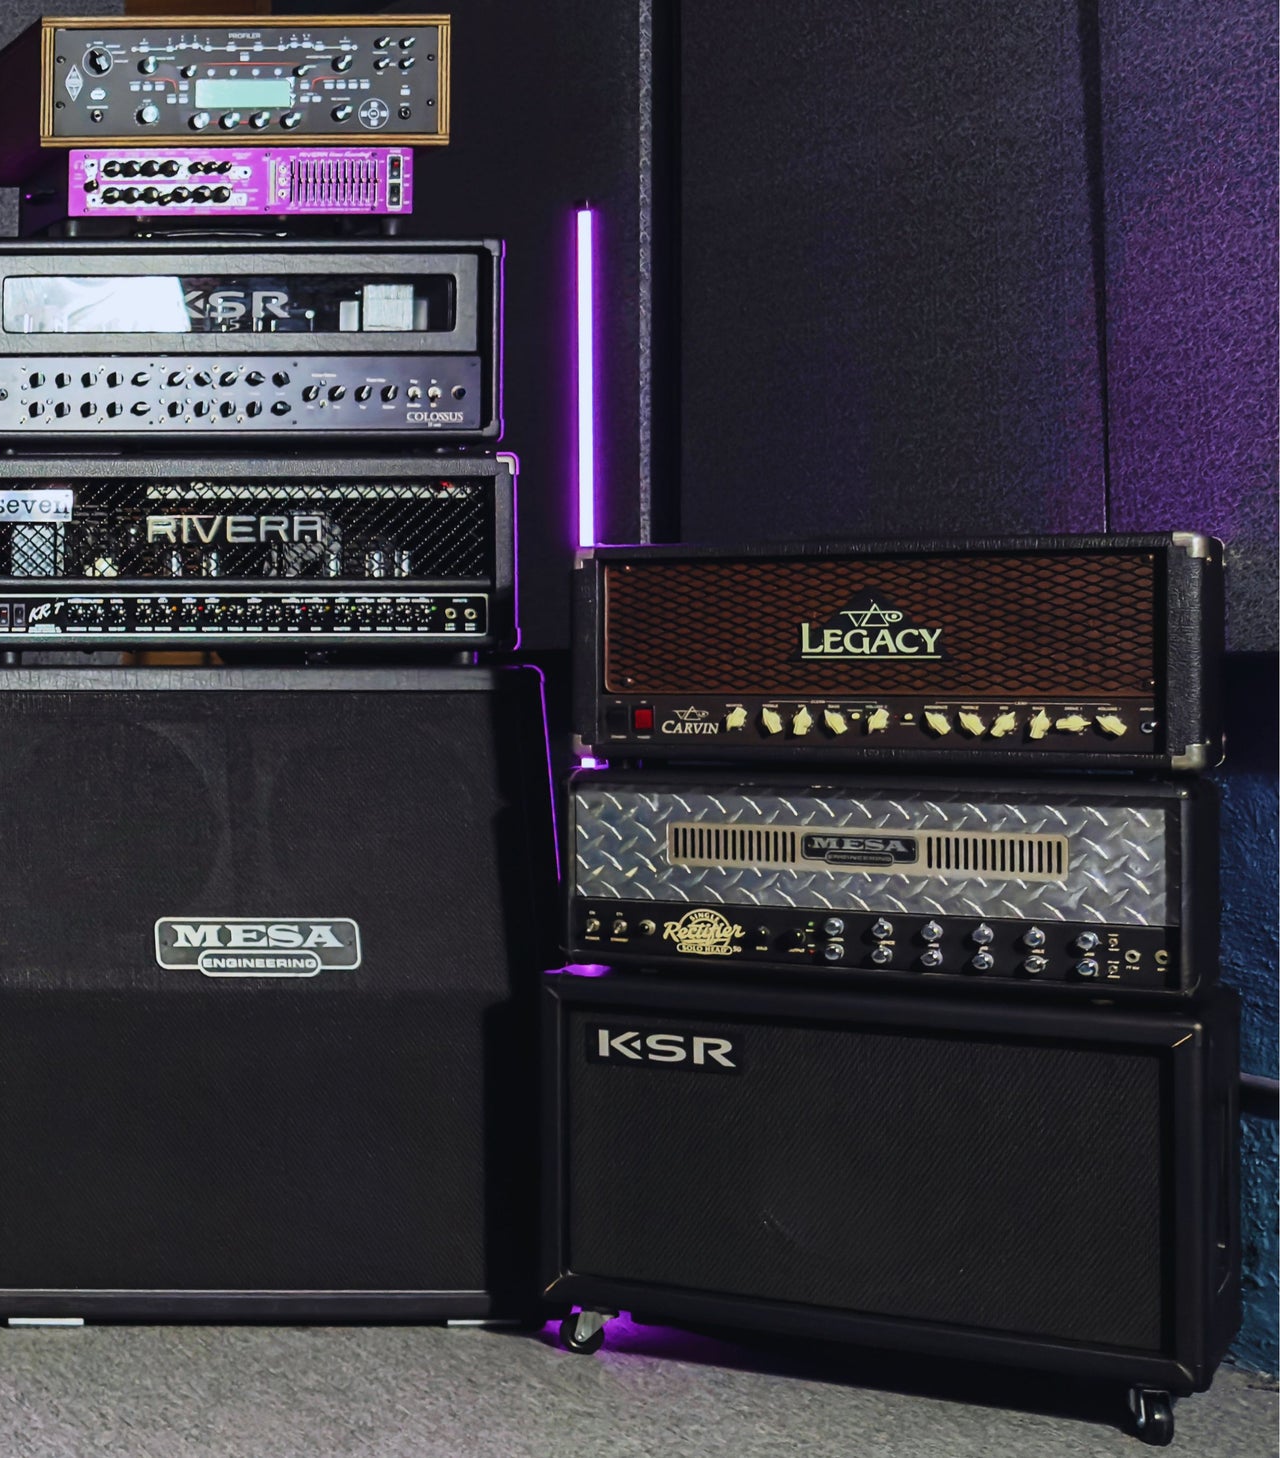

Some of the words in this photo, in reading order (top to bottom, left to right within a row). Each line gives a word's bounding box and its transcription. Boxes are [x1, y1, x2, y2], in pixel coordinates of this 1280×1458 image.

[406, 411, 464, 422] COLOSSUS
[146, 515, 322, 543] RIVERA
[800, 622, 942, 655] LEGACY
[661, 720, 720, 735] CARVIN
[811, 837, 909, 852] MESA
[689, 912, 721, 923] SINGLE
[171, 924, 345, 948] MESA
[663, 921, 746, 945] Rectifier
[203, 958, 317, 969] ENGINEERING
[598, 1028, 737, 1069] KSR
